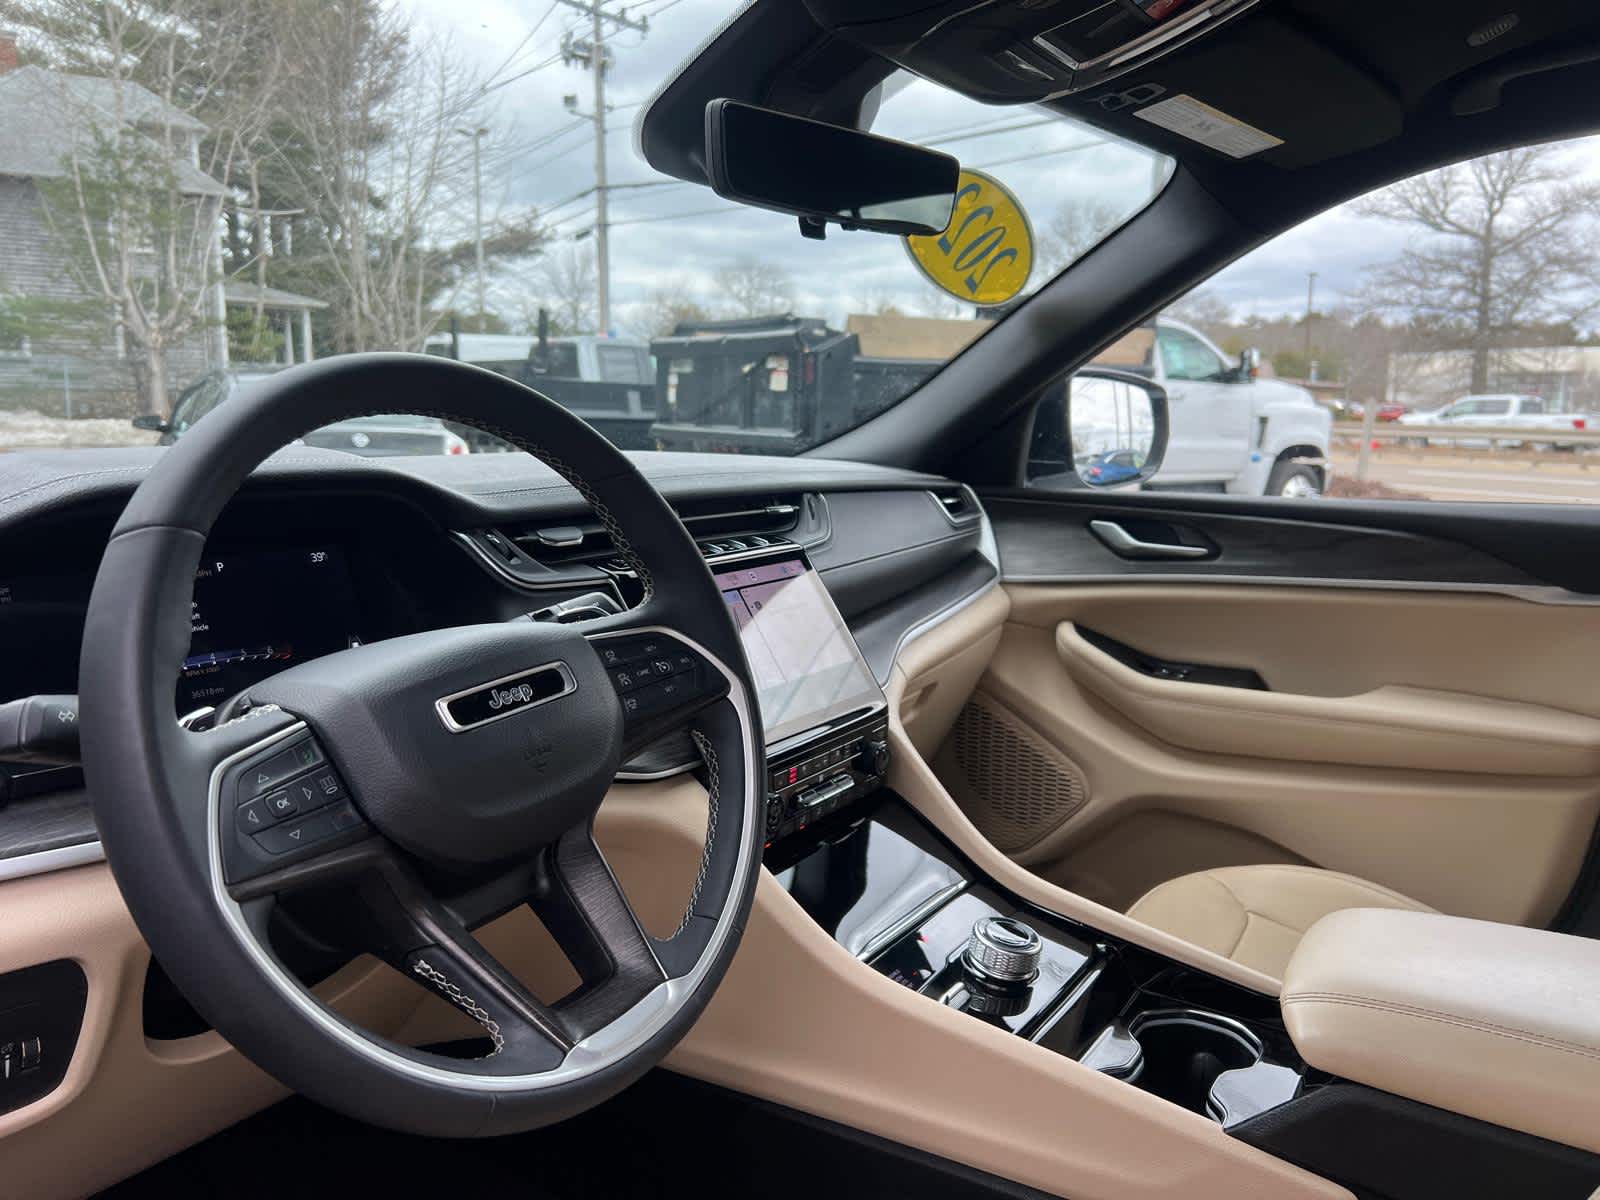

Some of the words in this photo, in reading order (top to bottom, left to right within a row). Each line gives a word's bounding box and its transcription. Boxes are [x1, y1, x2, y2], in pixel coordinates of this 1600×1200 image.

[216, 562, 224, 572] P
[489, 683, 533, 709] Jeep
[276, 797, 290, 809] OK
